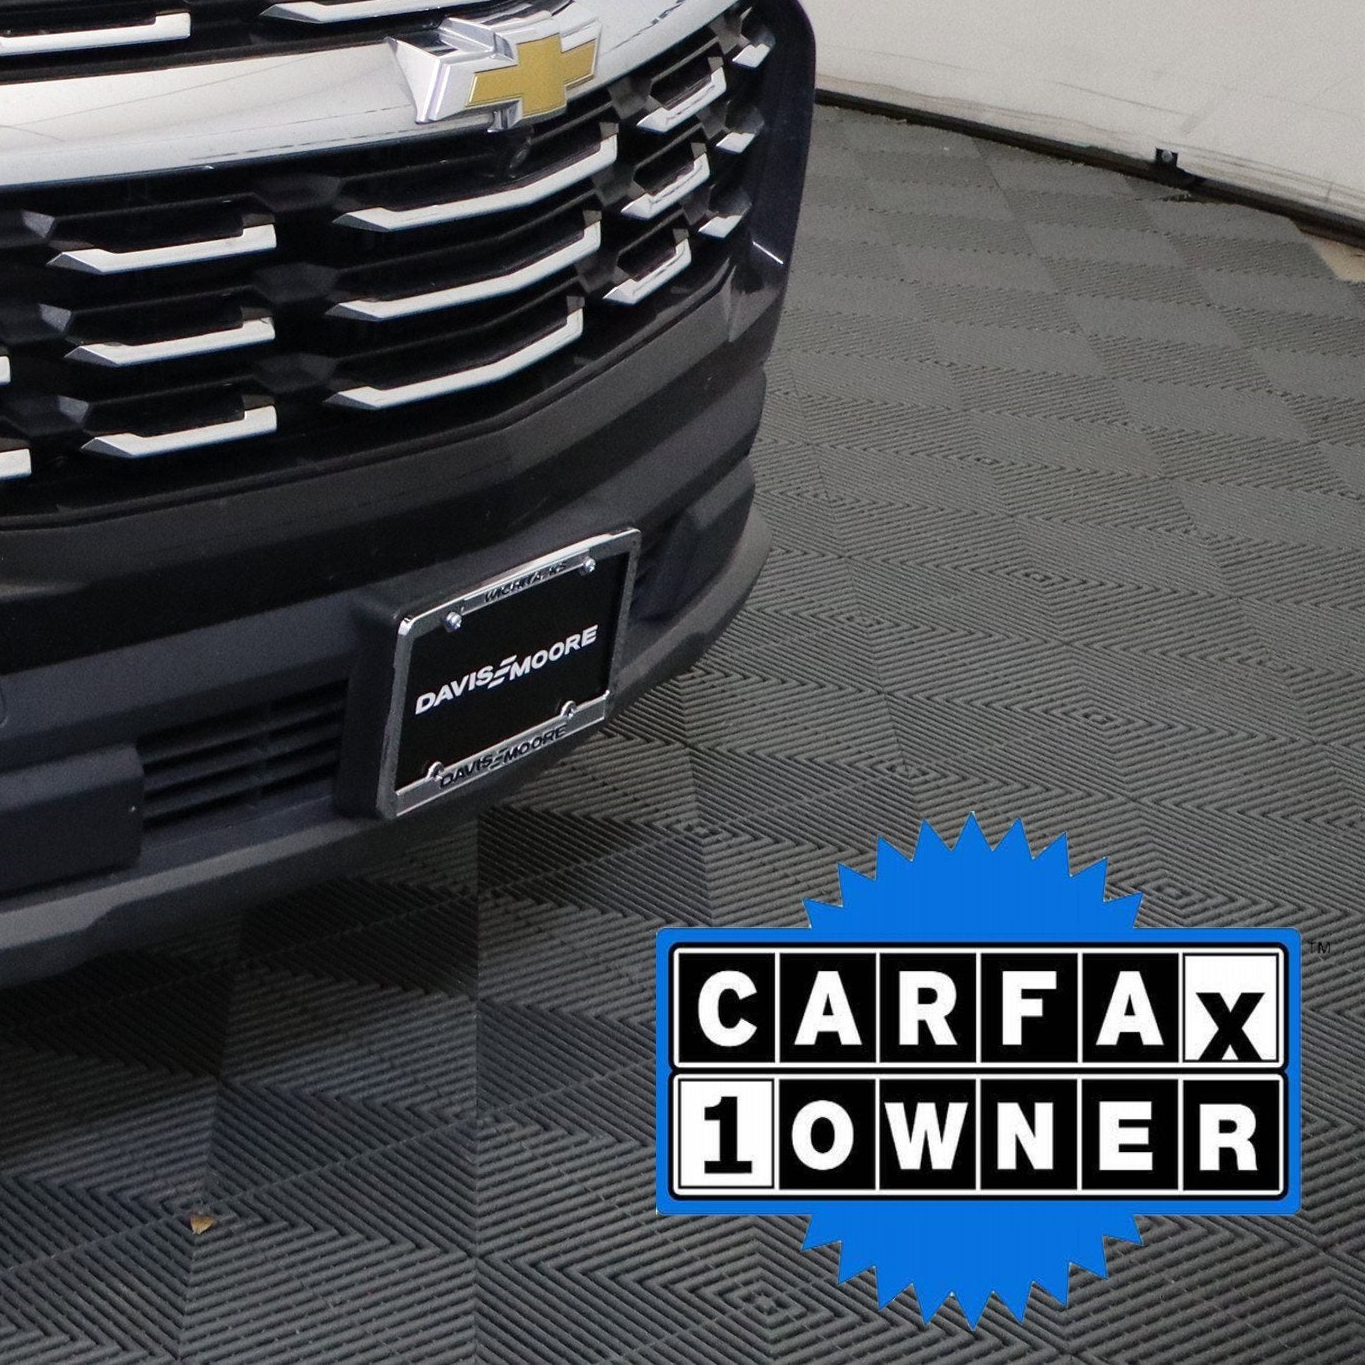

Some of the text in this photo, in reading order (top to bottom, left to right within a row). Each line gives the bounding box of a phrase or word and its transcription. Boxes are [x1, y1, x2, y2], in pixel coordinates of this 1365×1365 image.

[415, 625, 598, 715] DAVIS MOORE
[440, 724, 567, 788] DAVIS MOORE
